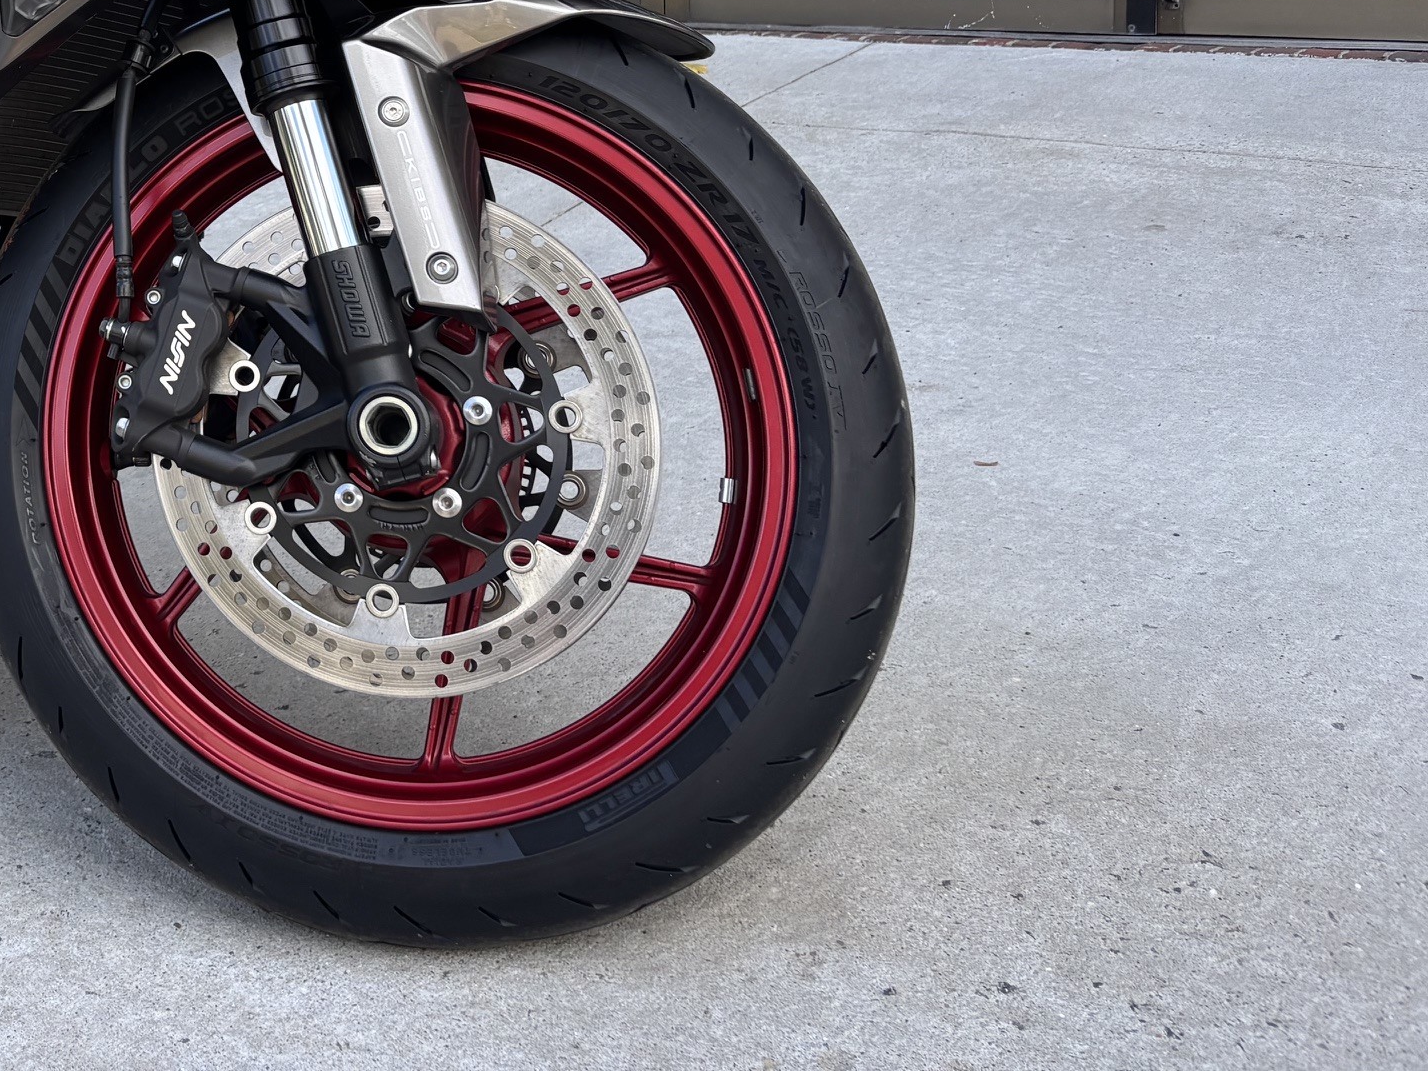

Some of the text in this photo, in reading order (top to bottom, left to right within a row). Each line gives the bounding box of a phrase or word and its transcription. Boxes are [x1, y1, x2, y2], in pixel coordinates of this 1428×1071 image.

[54, 135, 168, 267] DIALO
[405, 158, 432, 220] KIBS
[538, 75, 672, 151] 120/70
[676, 161, 760, 246] ZR17
[332, 260, 371, 339] SHOWA
[21, 451, 41, 545] ROTATION
